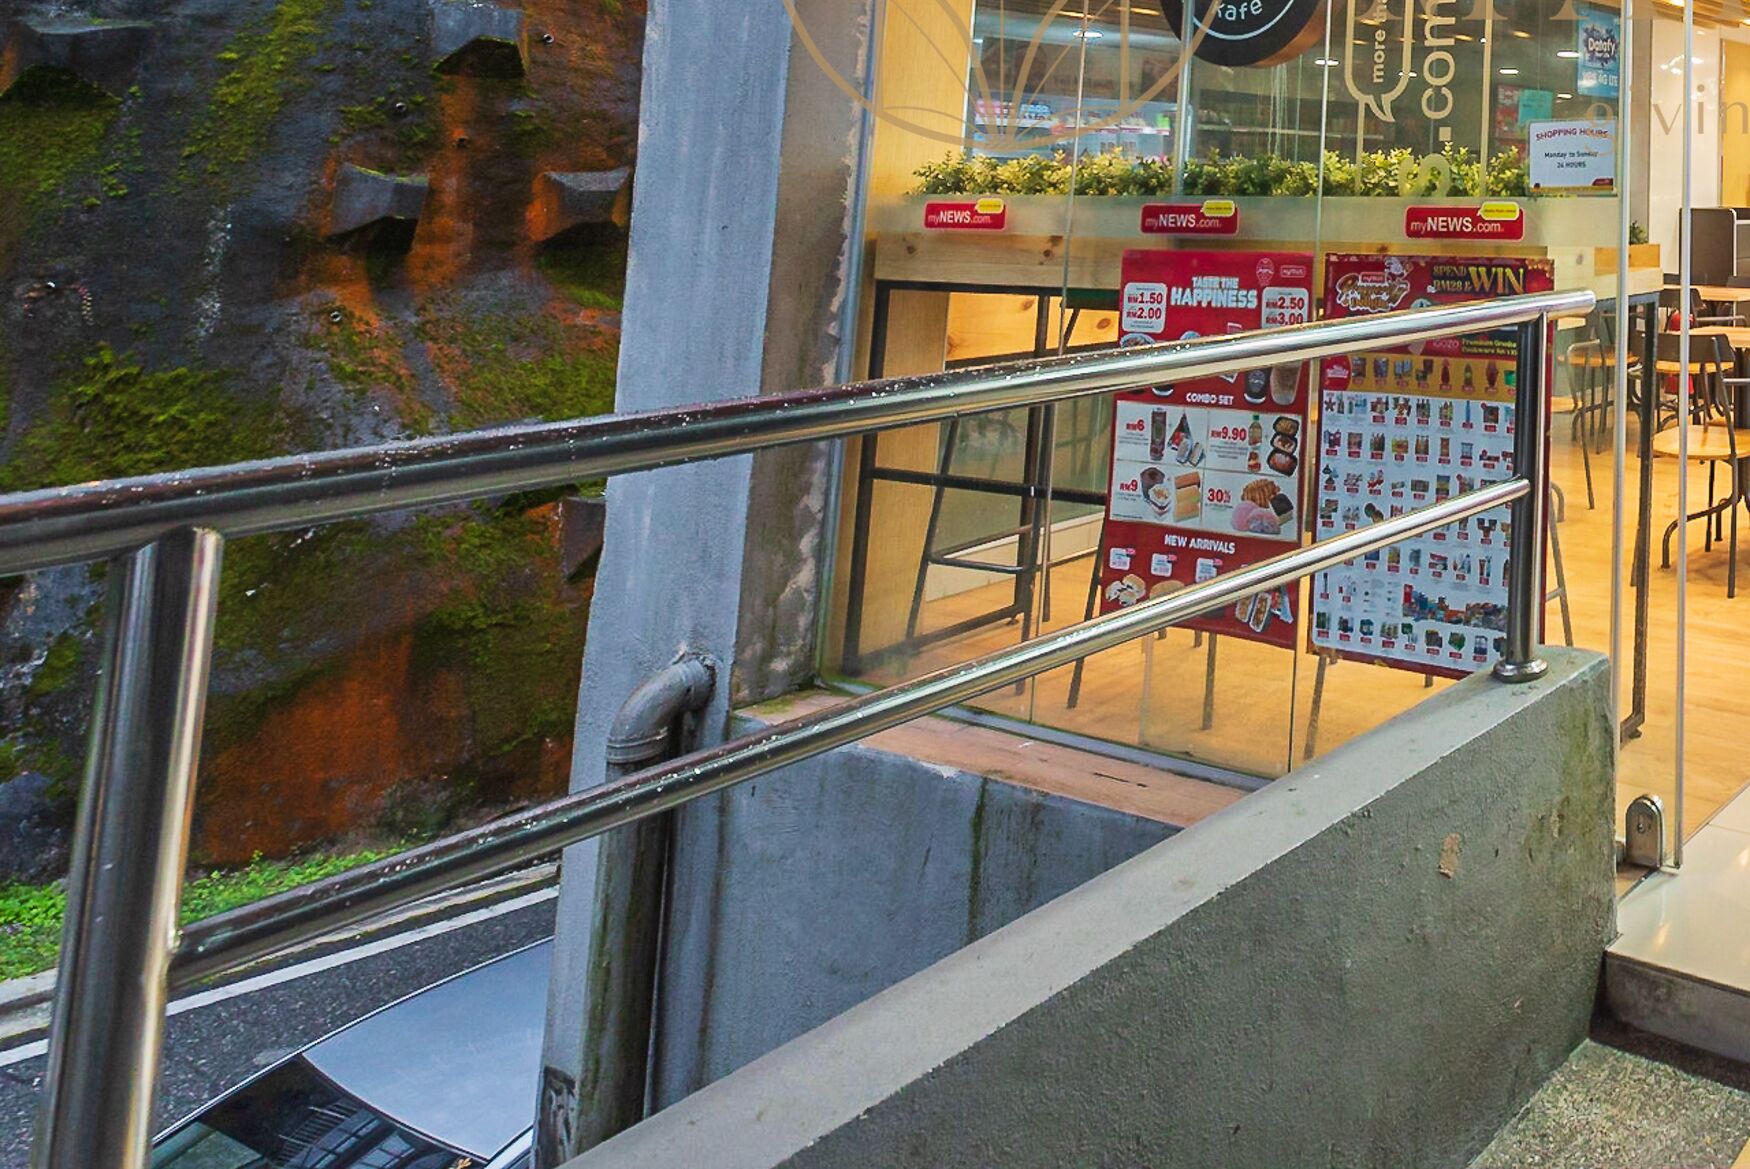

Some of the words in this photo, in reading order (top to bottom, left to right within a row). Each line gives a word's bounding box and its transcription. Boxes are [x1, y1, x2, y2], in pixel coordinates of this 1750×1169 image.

[1372, 29, 1387, 83] more
[1536, 128, 1577, 141] SHOPPING
[928, 210, 991, 225] myNEWS.com
[1145, 214, 1220, 230] myNEWS.com
[1410, 216, 1501, 234] myNEWS.com
[1468, 266, 1524, 294] WIN
[1170, 288, 1258, 309] HAPPINESS
[1186, 392, 1217, 404] COMBO
[1218, 394, 1234, 405] SET
[1210, 426, 1248, 441] RM9.90
[1164, 534, 1187, 549] NEW
[1189, 537, 1236, 554] ARRIVALS
